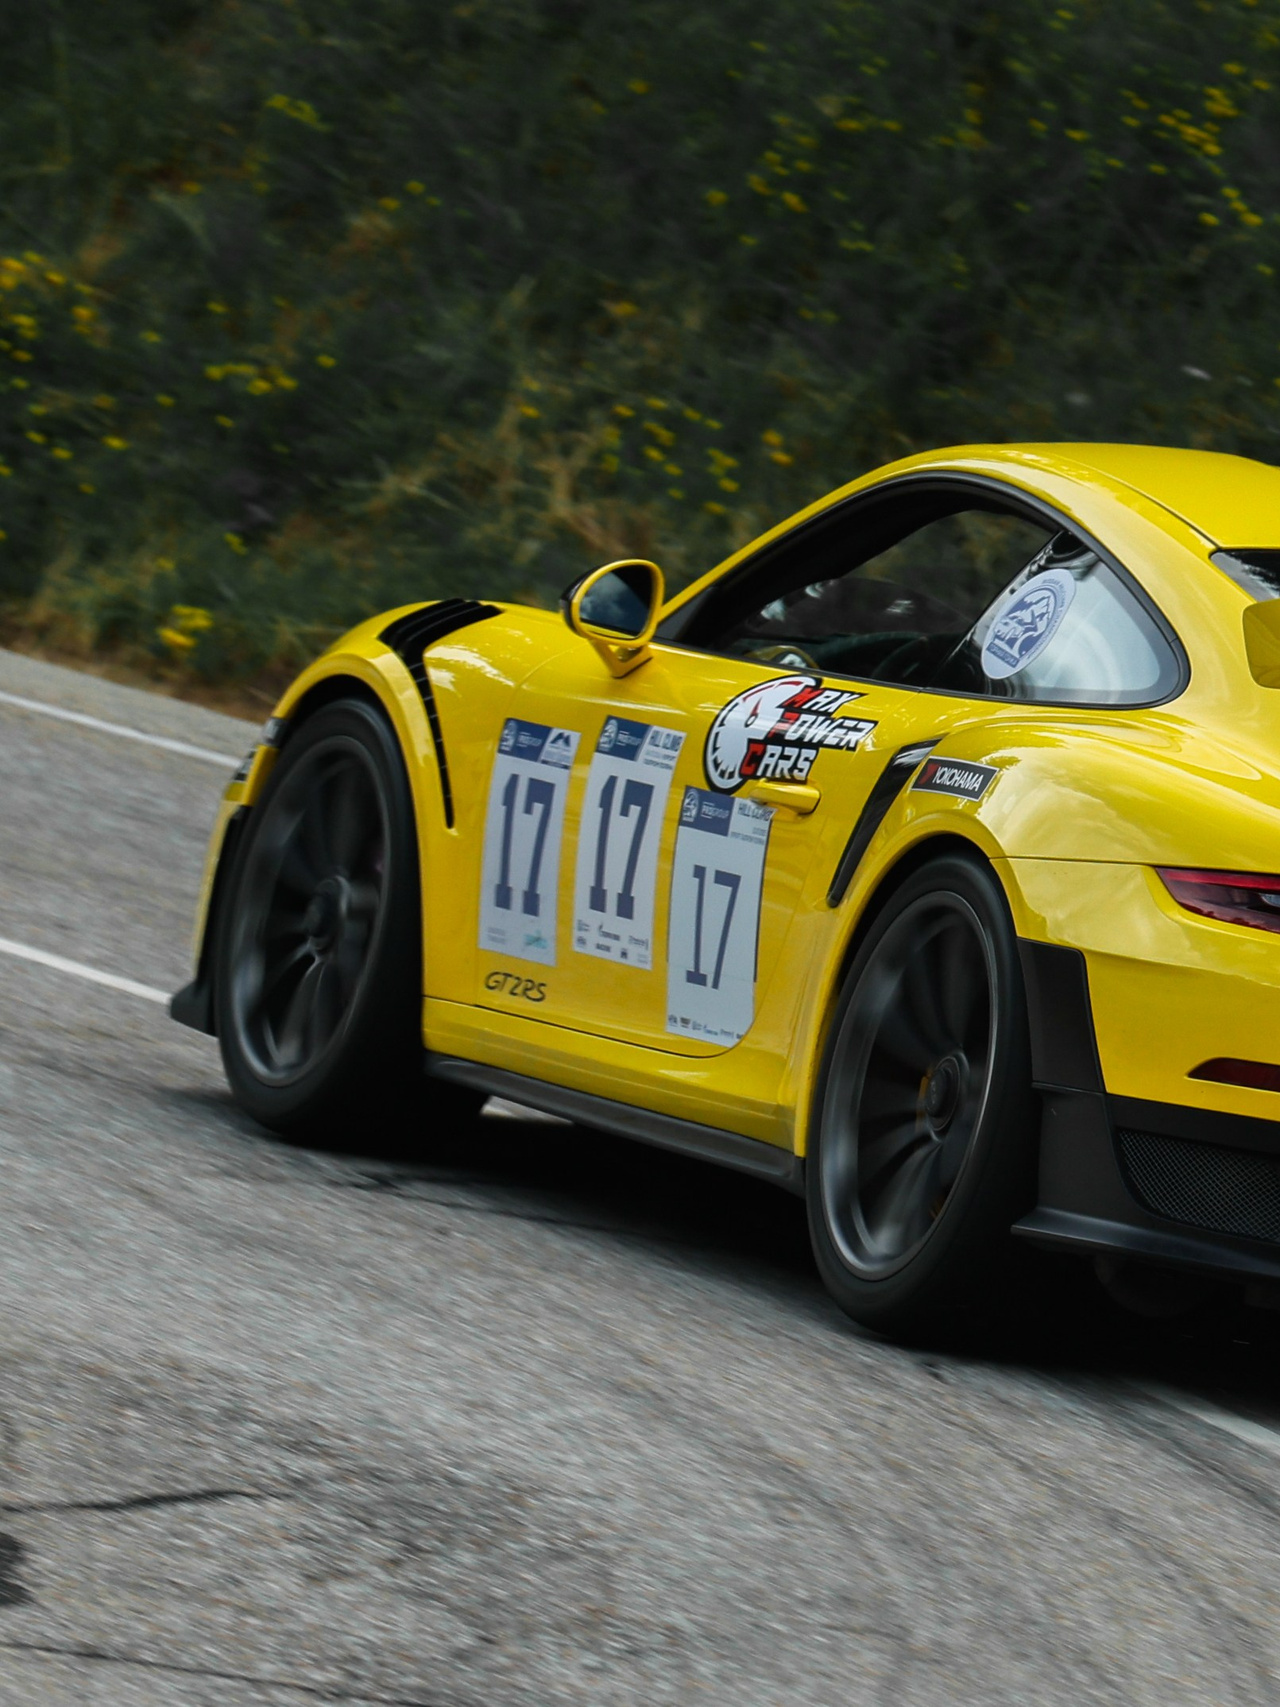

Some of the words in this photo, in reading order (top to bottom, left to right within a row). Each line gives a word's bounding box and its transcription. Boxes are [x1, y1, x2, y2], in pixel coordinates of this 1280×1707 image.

[781, 686, 861, 713] MAX
[767, 711, 876, 748] POWER
[740, 742, 817, 781] CARS
[932, 766, 984, 792] YOKOHAMA
[494, 773, 556, 918] 17
[588, 774, 655, 920] 17
[685, 864, 742, 990] 17
[485, 971, 548, 1002] GT2RS
